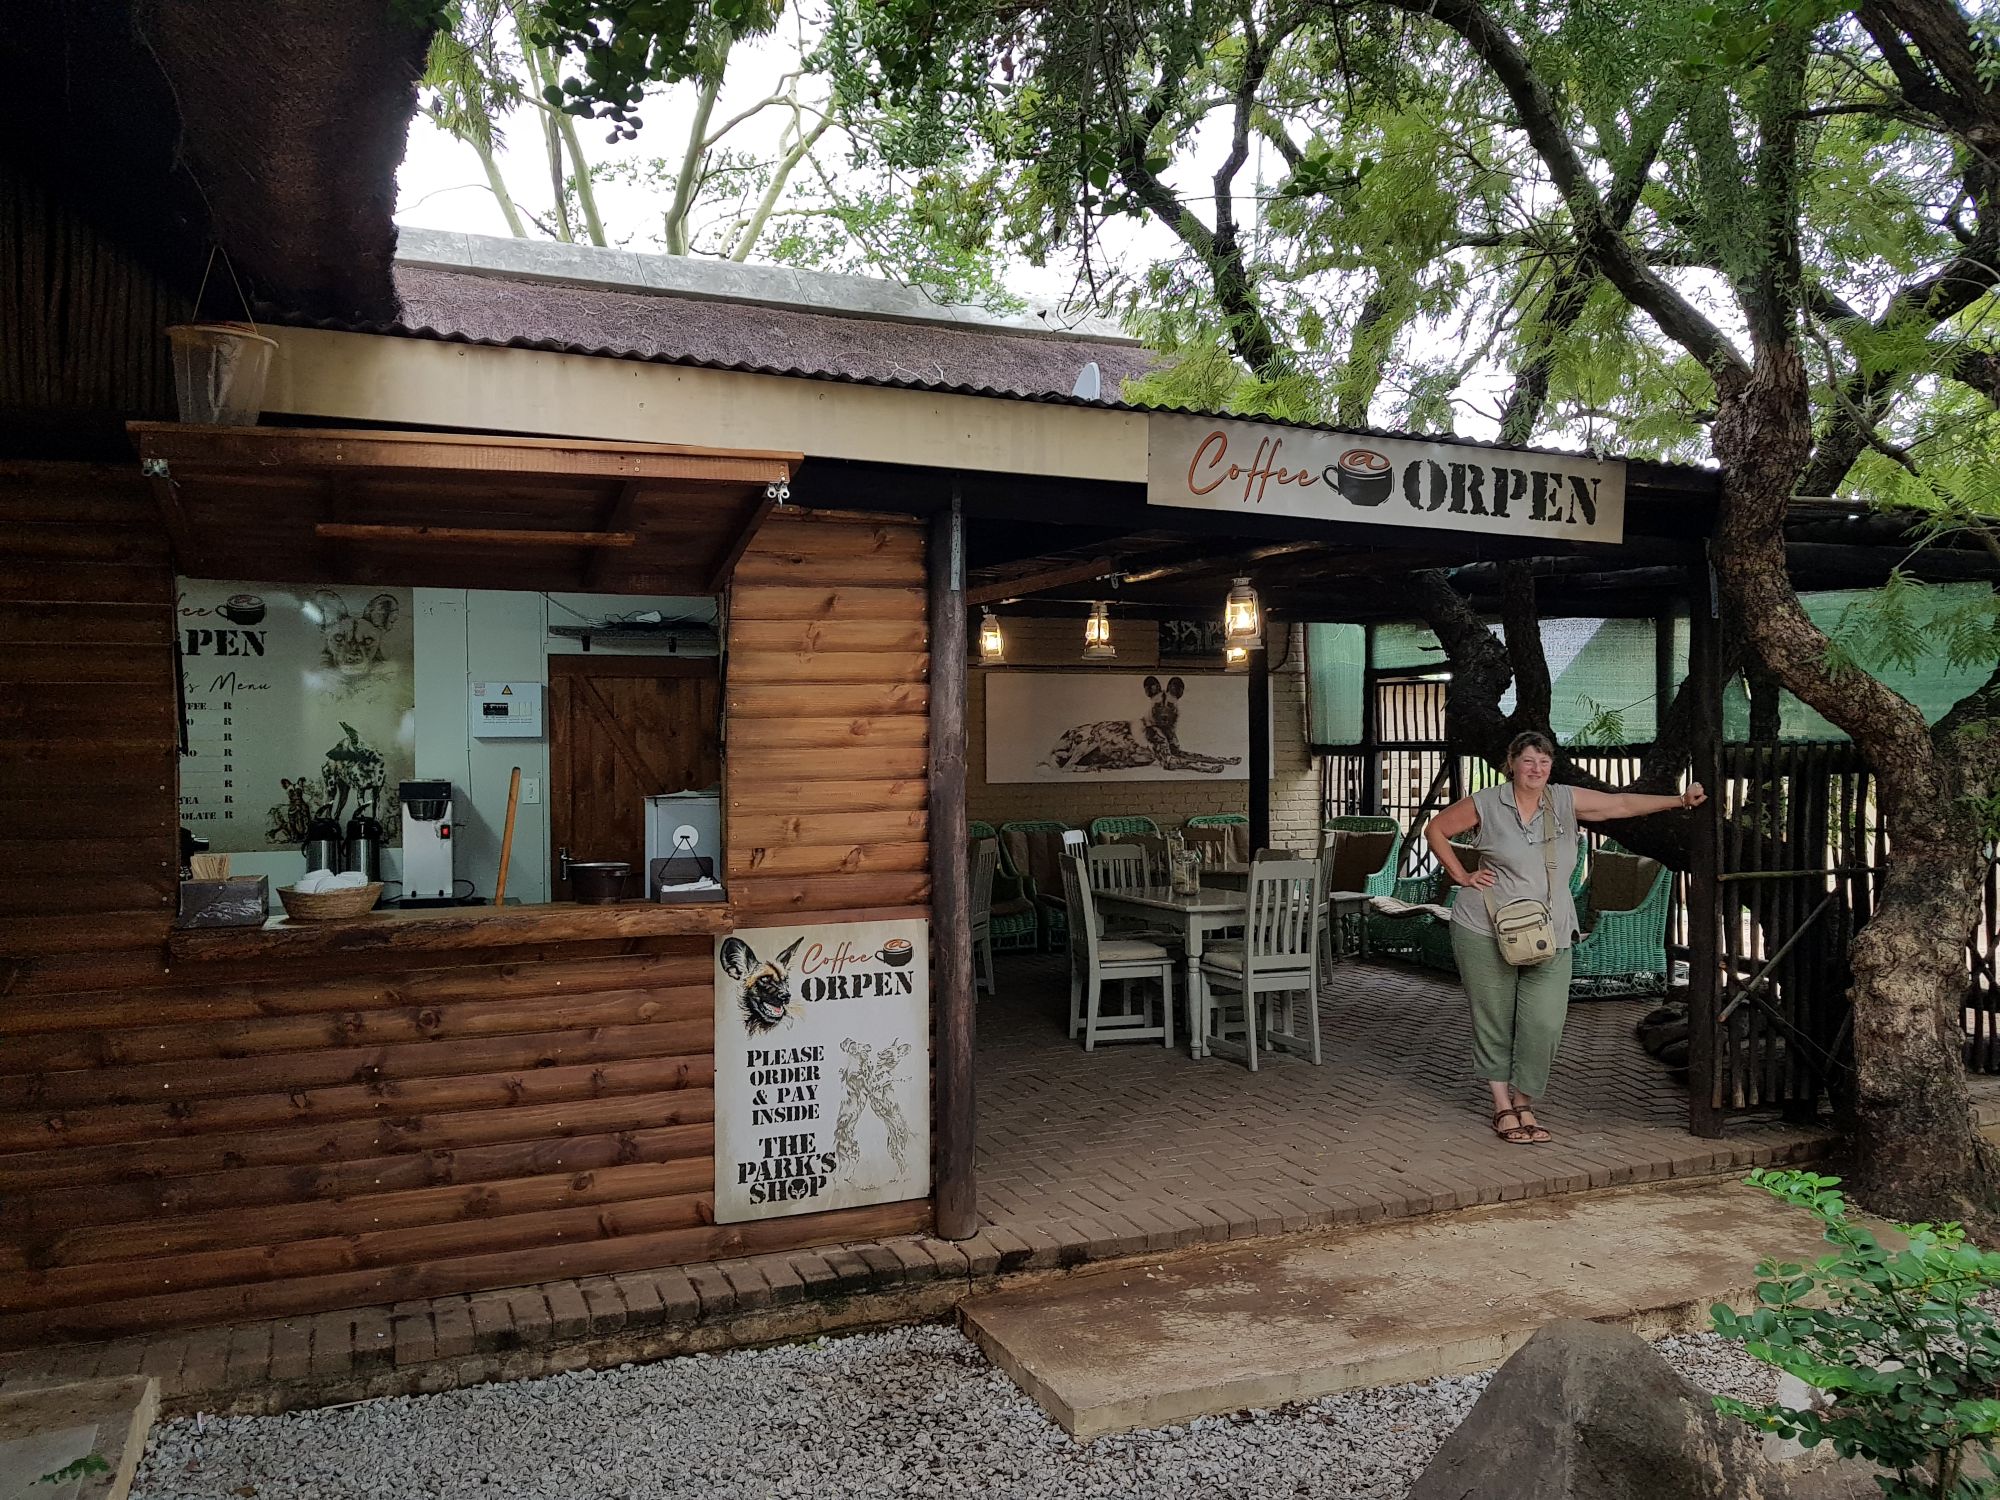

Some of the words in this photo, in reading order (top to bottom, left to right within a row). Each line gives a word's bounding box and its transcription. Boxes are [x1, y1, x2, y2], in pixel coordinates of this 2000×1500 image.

[1187, 430, 1320, 504] Coffee
[1402, 458, 1602, 526] ORPEN
[179, 629, 267, 656] PEN
[209, 671, 271, 697] Menu
[224, 733, 232, 741] R
[224, 749, 232, 757] R
[224, 764, 232, 772] R
[225, 795, 233, 803] R
[181, 811, 217, 820] OLATE
[225, 811, 233, 819] R
[801, 941, 873, 975] Coffee
[800, 970, 914, 1002] ORPEN
[746, 1045, 824, 1068] PLEASE
[749, 1066, 821, 1086] ORDER
[752, 1089, 768, 1106] &
[777, 1084, 818, 1103] PAY
[751, 1103, 820, 1126] INSIDE
[758, 1133, 816, 1159] THE
[737, 1152, 837, 1185] PARK'S
[749, 1175, 827, 1205] SHOP
